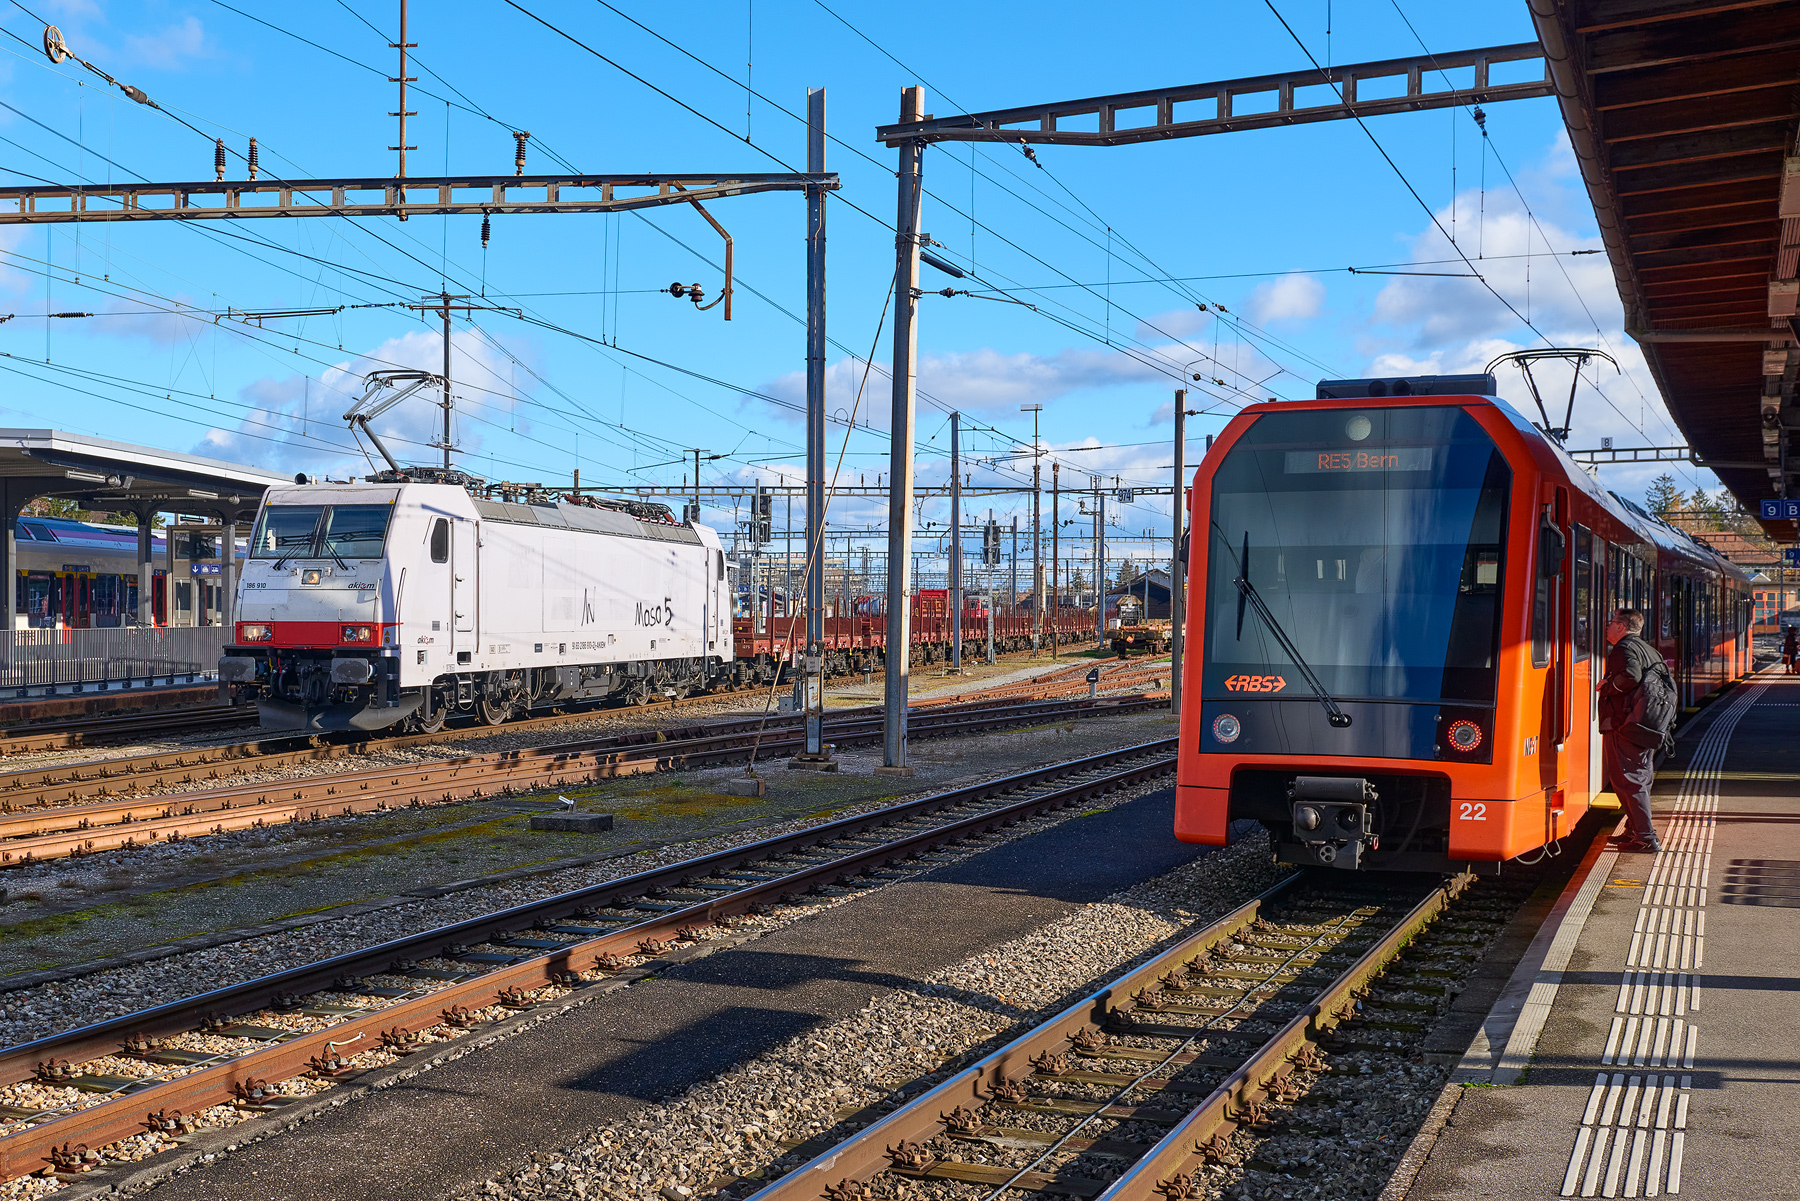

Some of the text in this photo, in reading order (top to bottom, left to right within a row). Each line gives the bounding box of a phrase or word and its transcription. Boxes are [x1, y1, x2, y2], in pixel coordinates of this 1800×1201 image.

[1604, 438, 1610, 447] 8
[1318, 452, 1399, 469] RE5 Bern
[1118, 489, 1131, 501] 974
[1767, 505, 1798, 516] 9 B
[1235, 675, 1275, 692] RBS
[1459, 802, 1487, 821] 22
